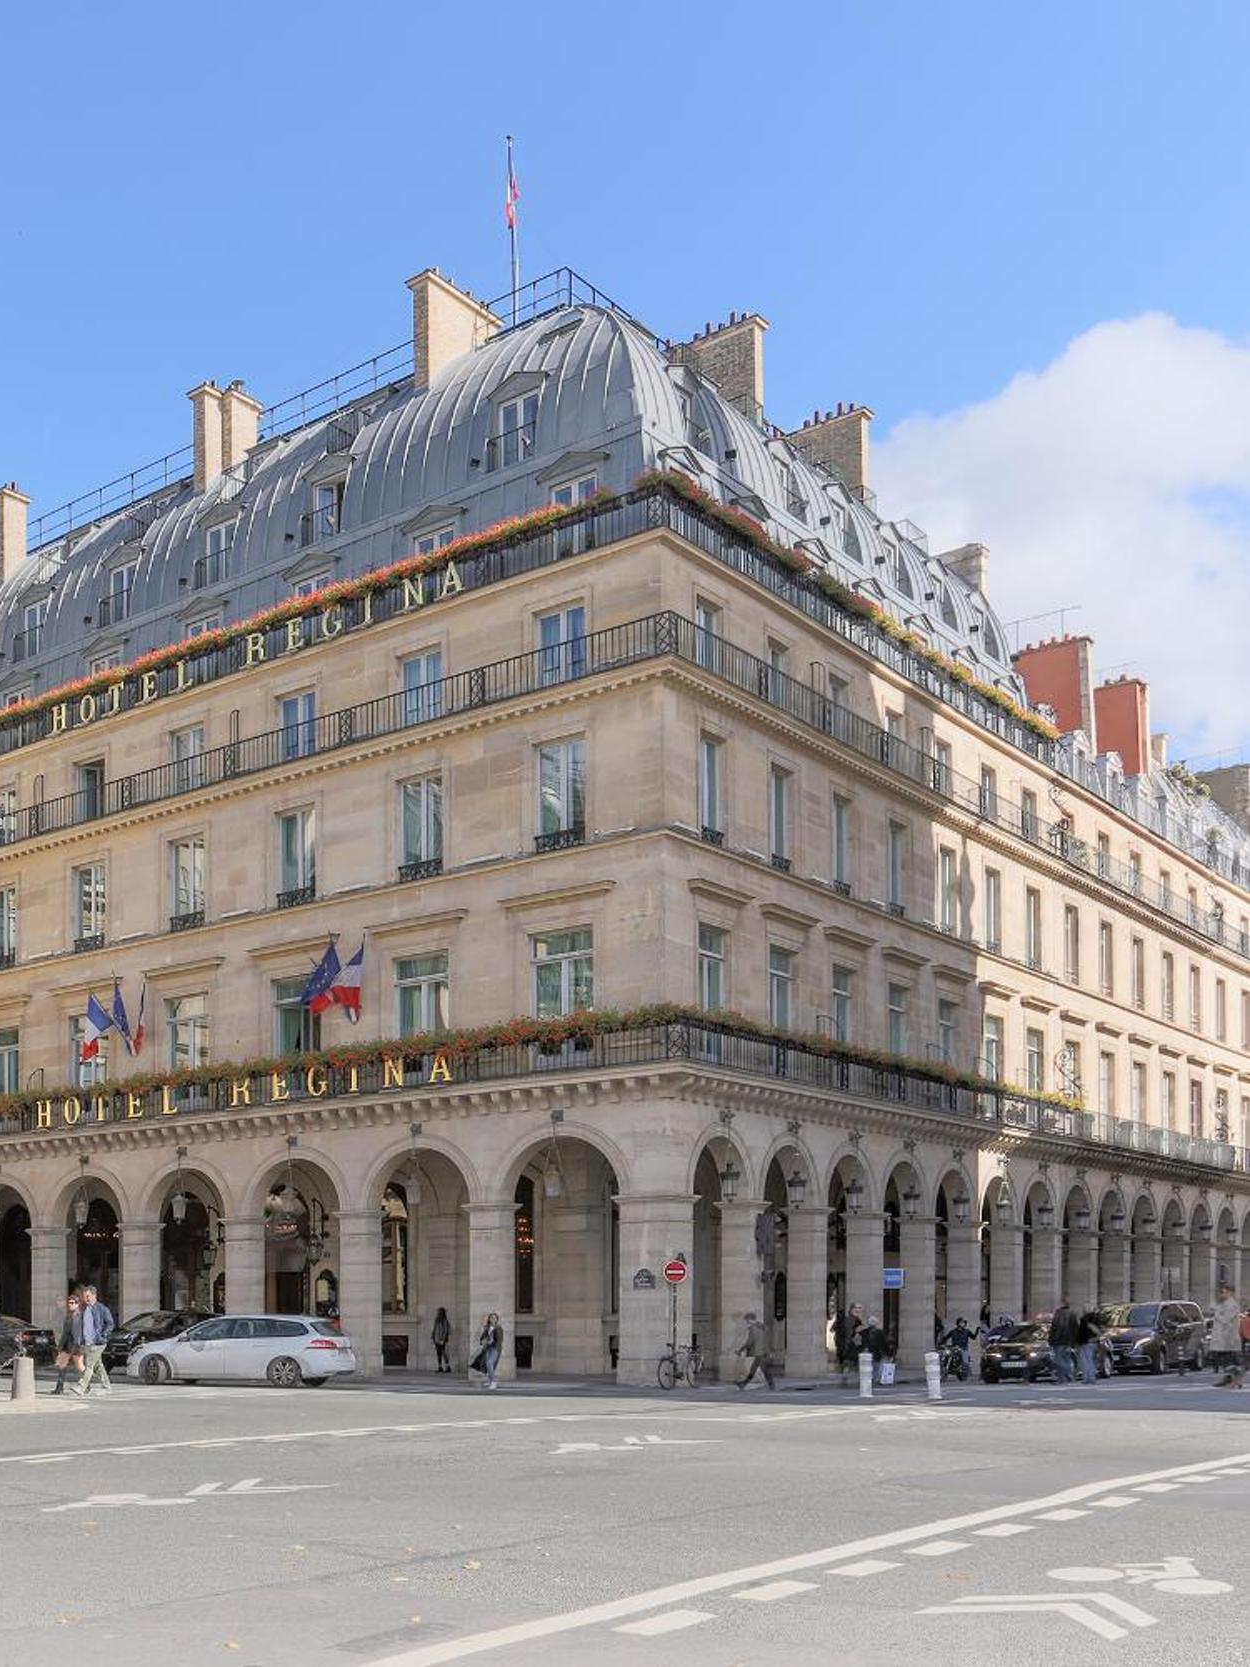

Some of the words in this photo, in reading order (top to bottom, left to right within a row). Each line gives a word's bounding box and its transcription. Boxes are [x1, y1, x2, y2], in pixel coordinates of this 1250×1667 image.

[52, 659, 194, 733] HOTEL
[246, 560, 464, 666] REGINA
[230, 1053, 454, 1106] REGINA
